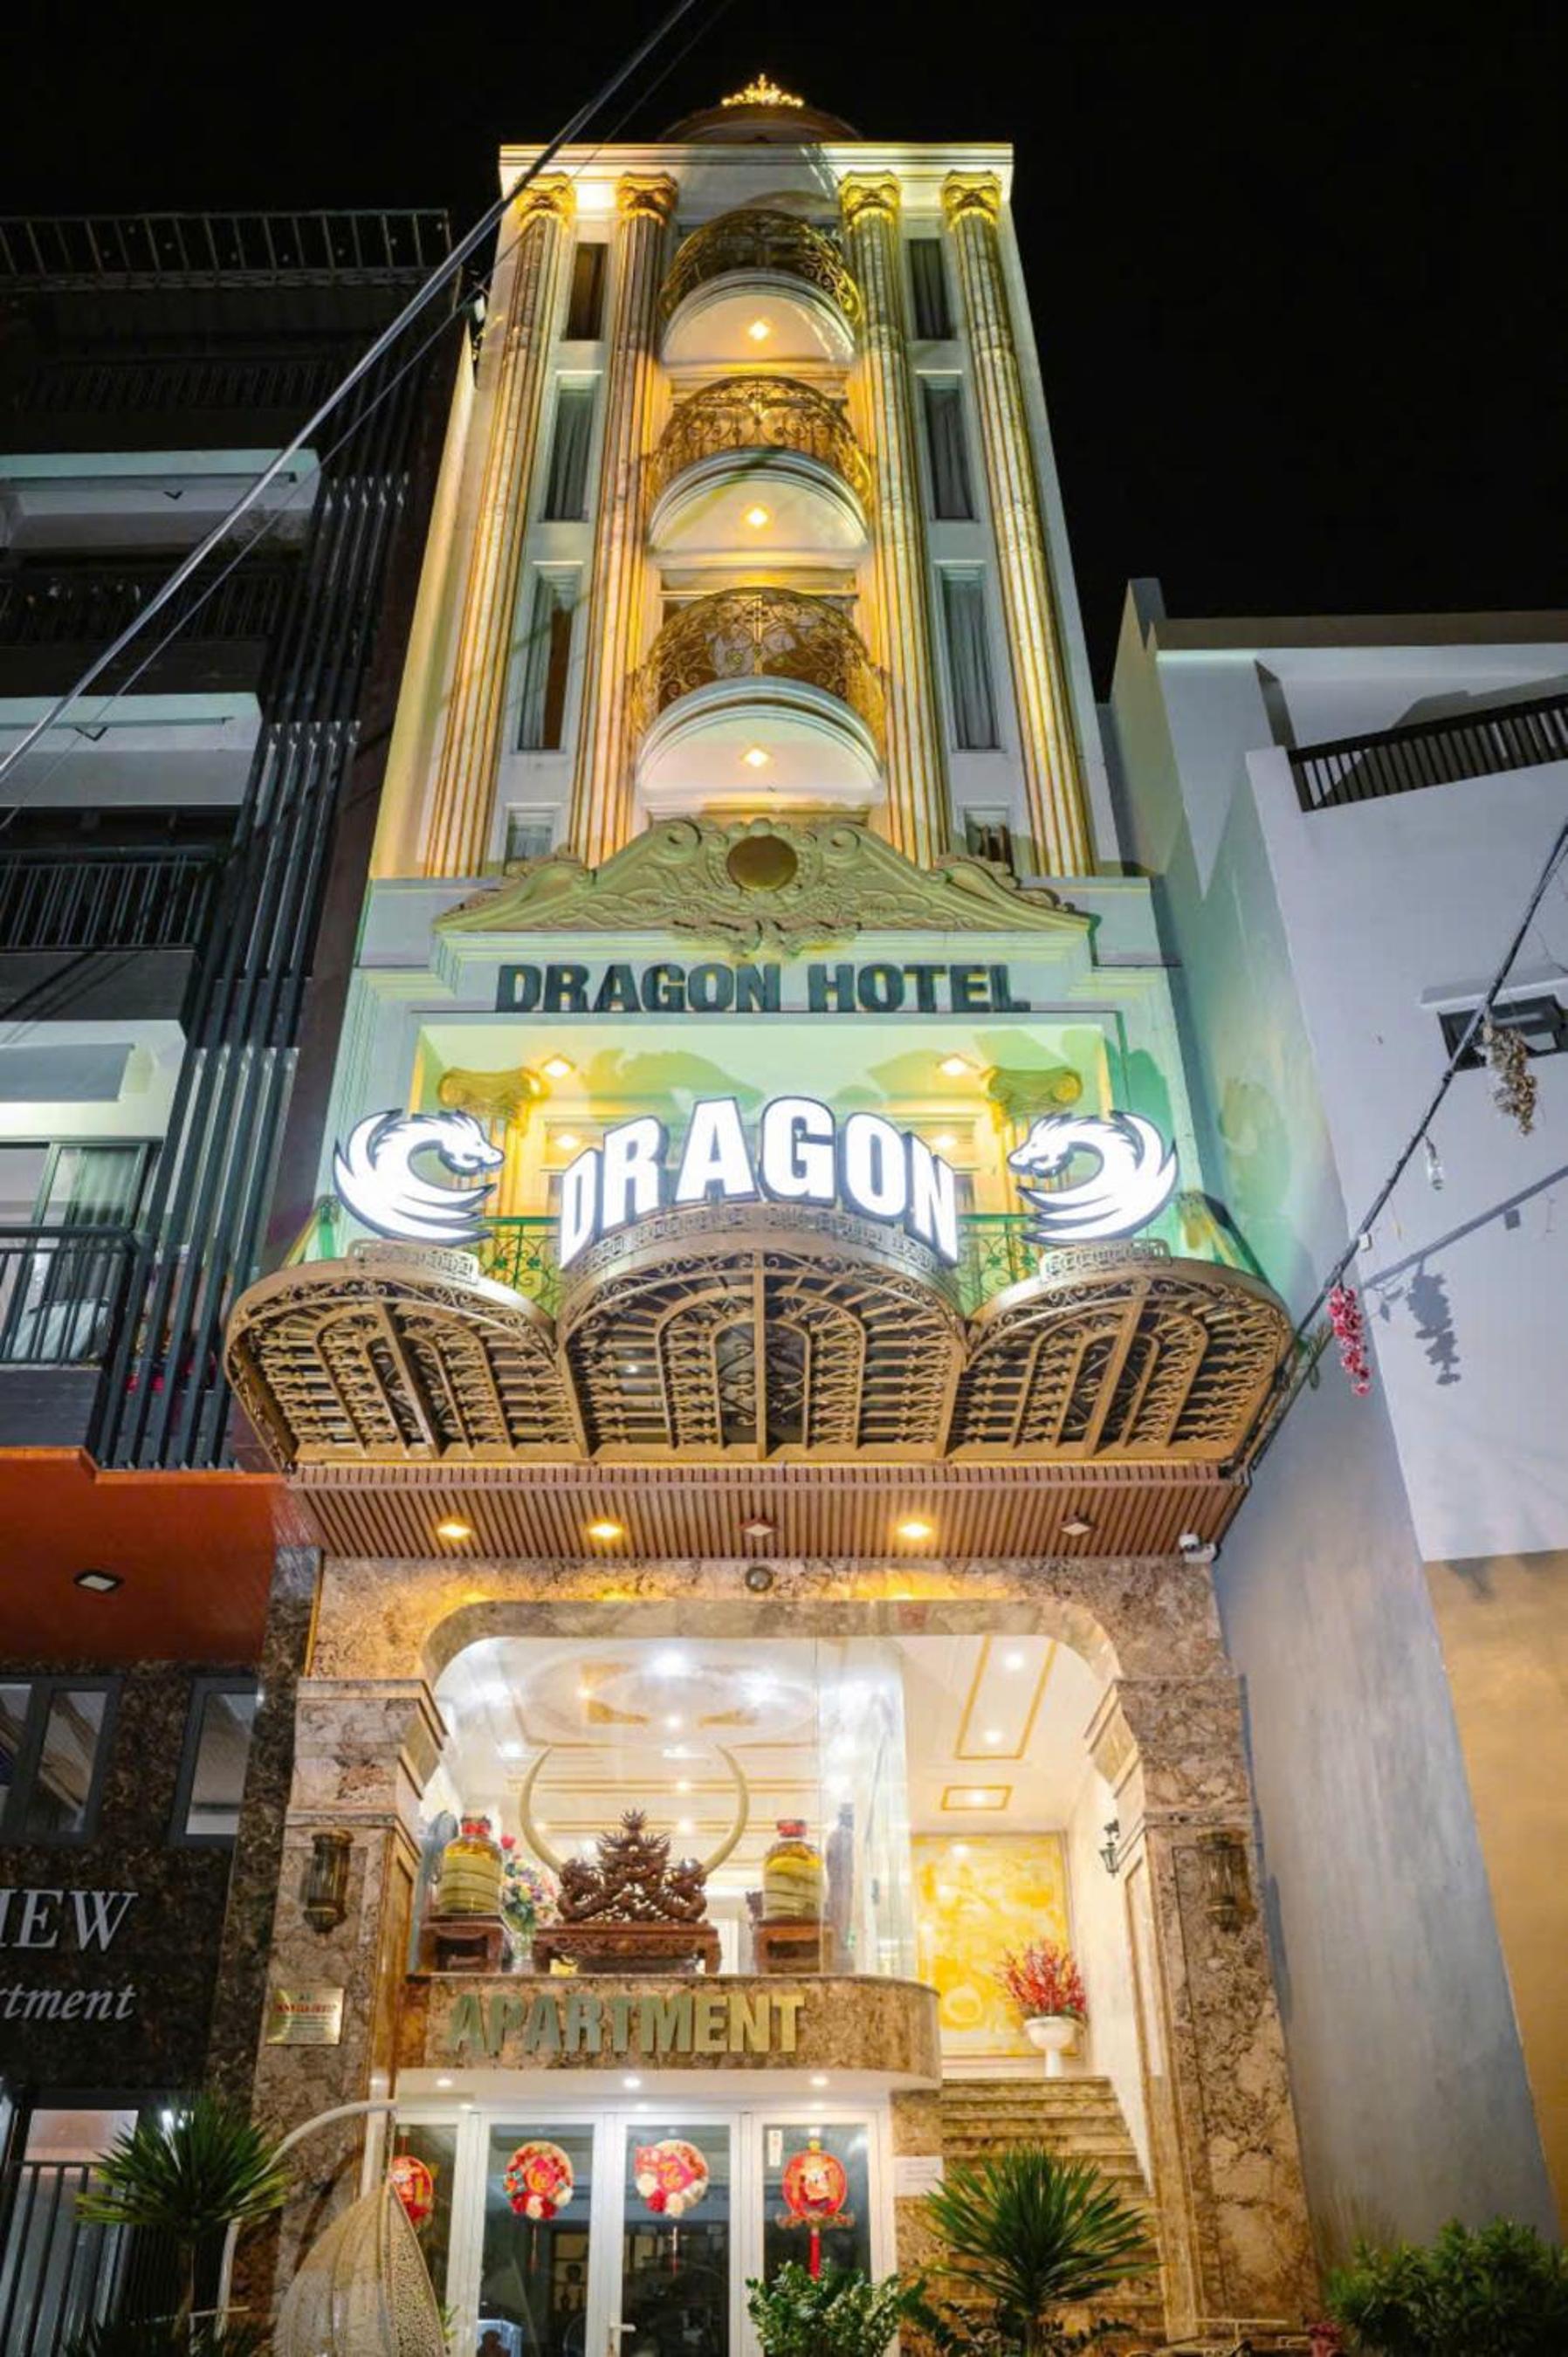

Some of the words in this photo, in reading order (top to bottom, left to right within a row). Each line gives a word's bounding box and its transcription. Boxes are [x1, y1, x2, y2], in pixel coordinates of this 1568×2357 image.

[495, 964, 781, 1011] DRAGON
[808, 964, 1031, 1012] HOTEL
[560, 1096, 959, 1270] DRAGON
[447, 1993, 805, 2052] APARTMENT
